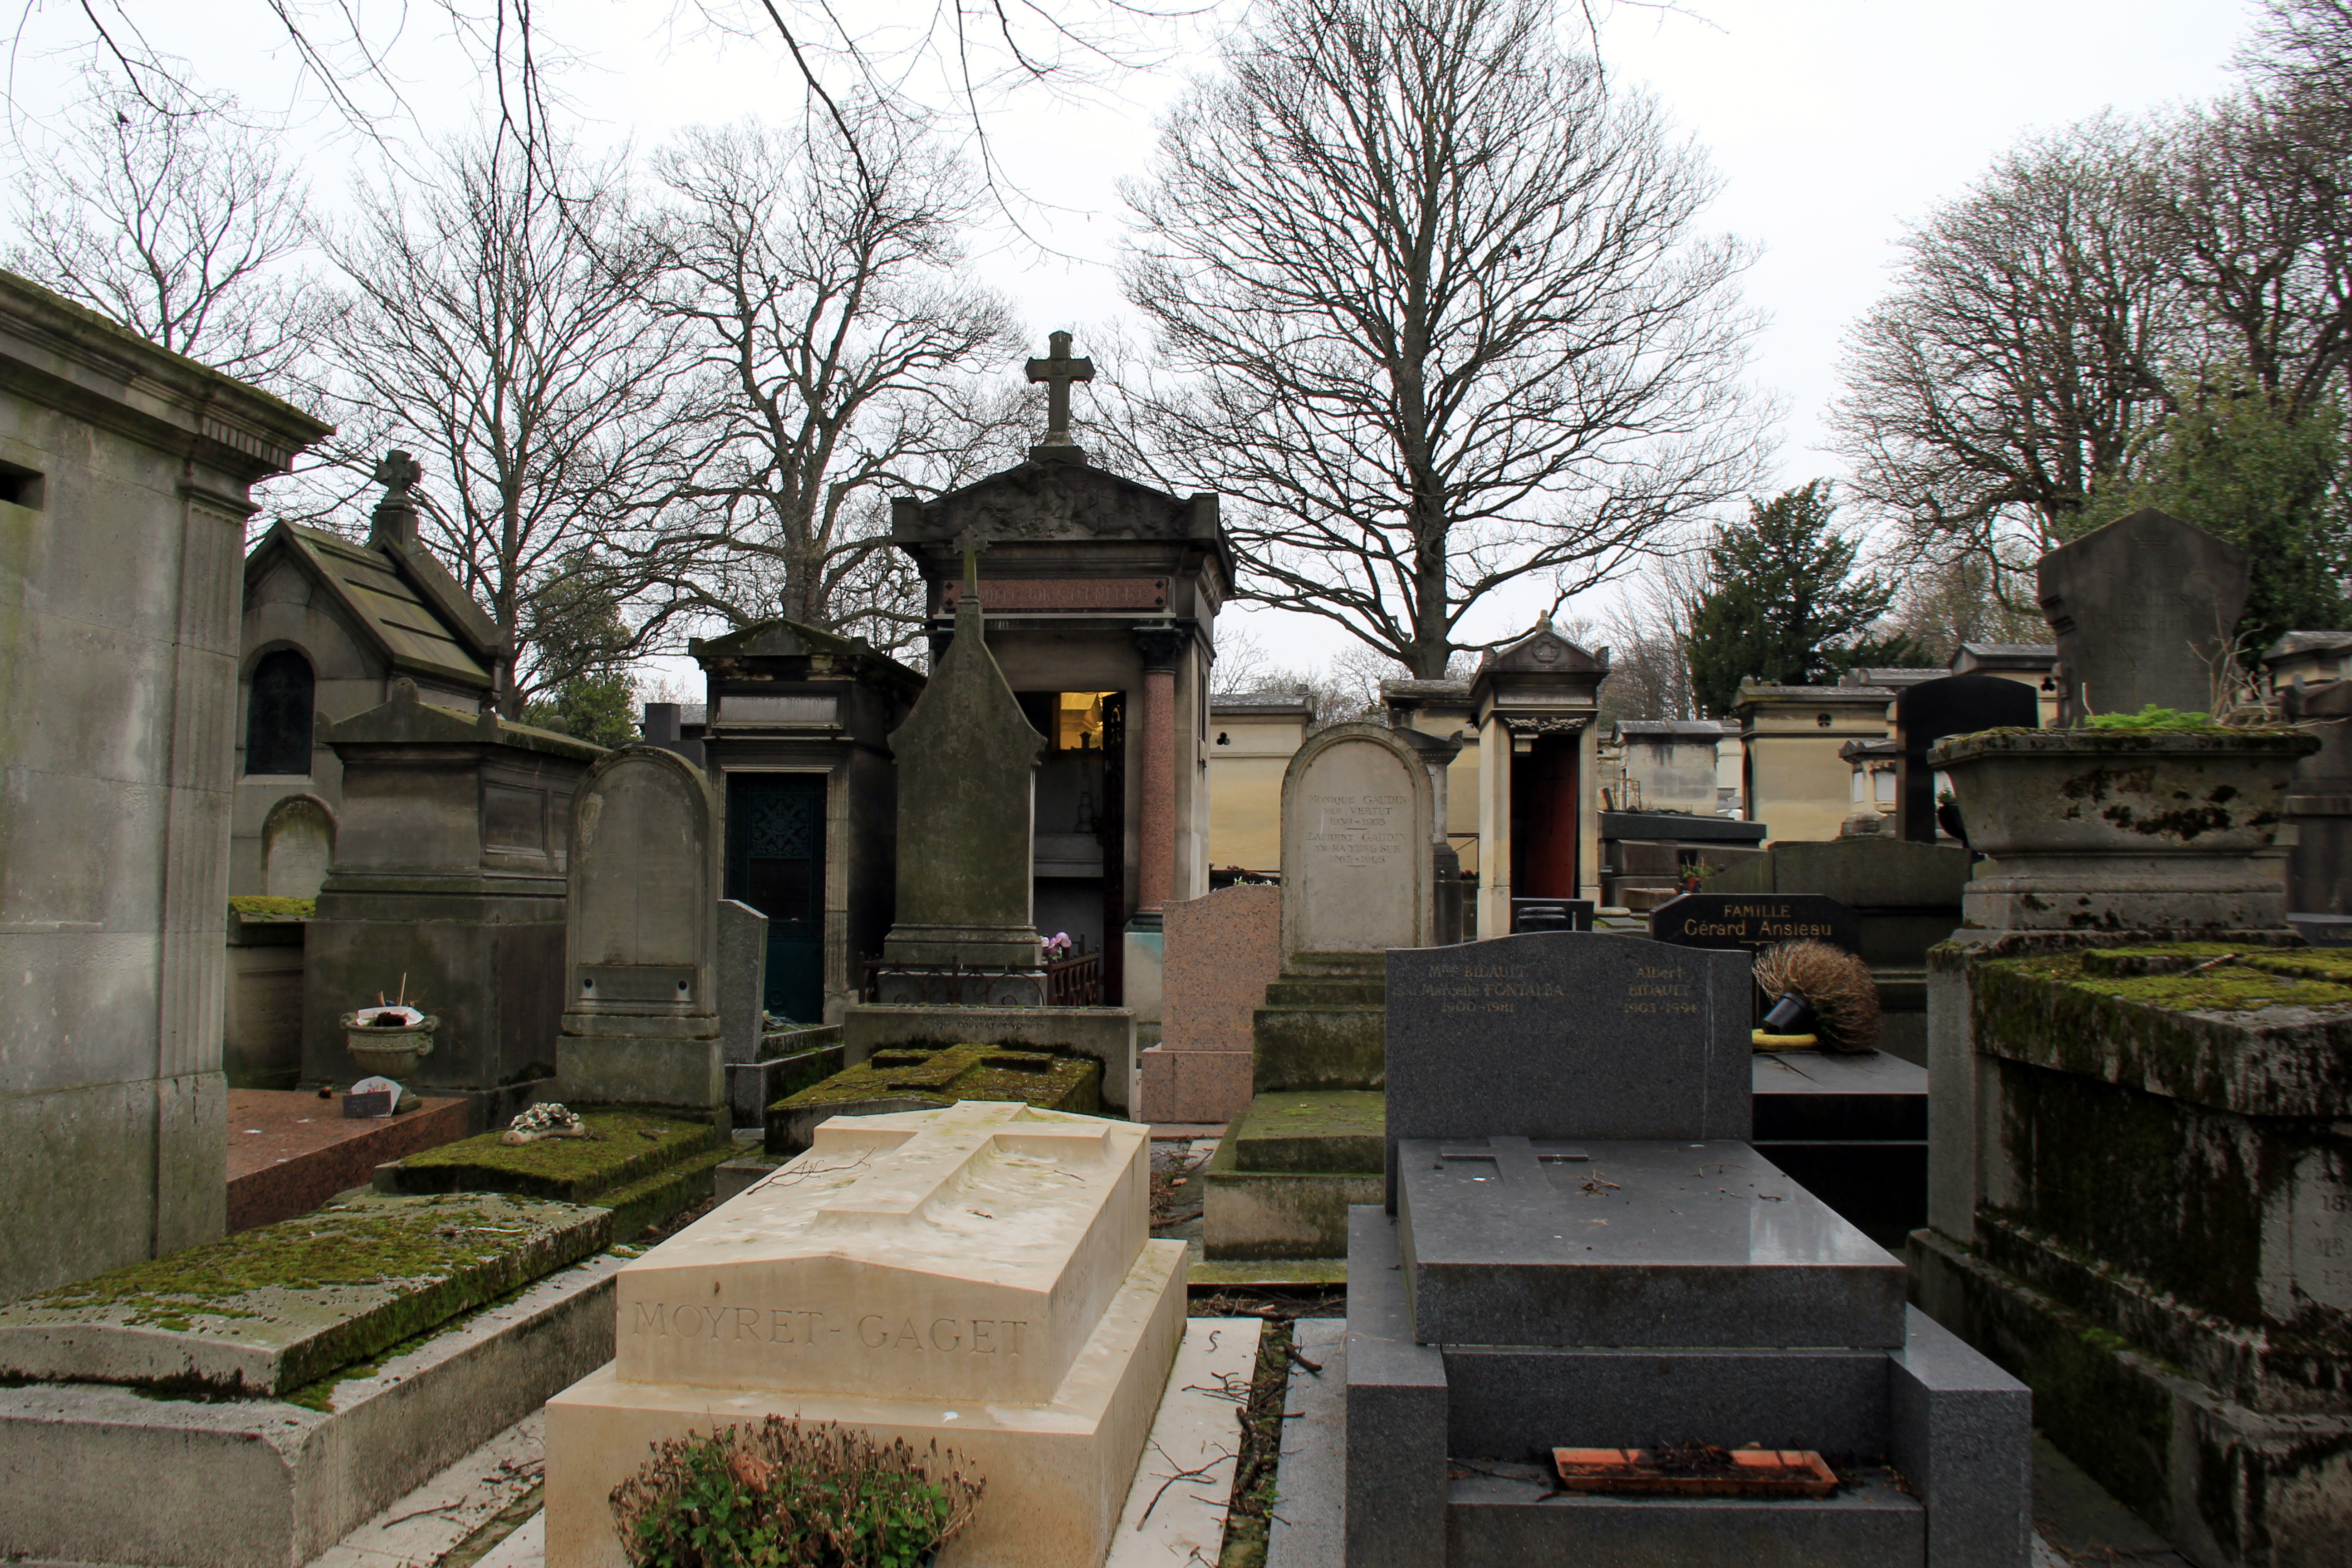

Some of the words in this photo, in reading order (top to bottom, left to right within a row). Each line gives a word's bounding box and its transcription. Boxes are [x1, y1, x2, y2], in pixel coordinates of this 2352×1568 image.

[1308, 795, 1355, 805] MONIQUE
[1363, 795, 1407, 804] GAUDIN
[1350, 807, 1392, 815] VERTUT
[1306, 832, 1354, 841] LAURENT
[1362, 833, 1407, 842] GAUDIN
[1725, 905, 1791, 917] FAMILLE
[1684, 919, 1746, 936] Gérard
[1759, 921, 1833, 936] Ansieau
[1465, 965, 1526, 977] BIDAULT
[1637, 966, 1684, 978] Albert
[1629, 985, 1691, 996] BIDAULT
